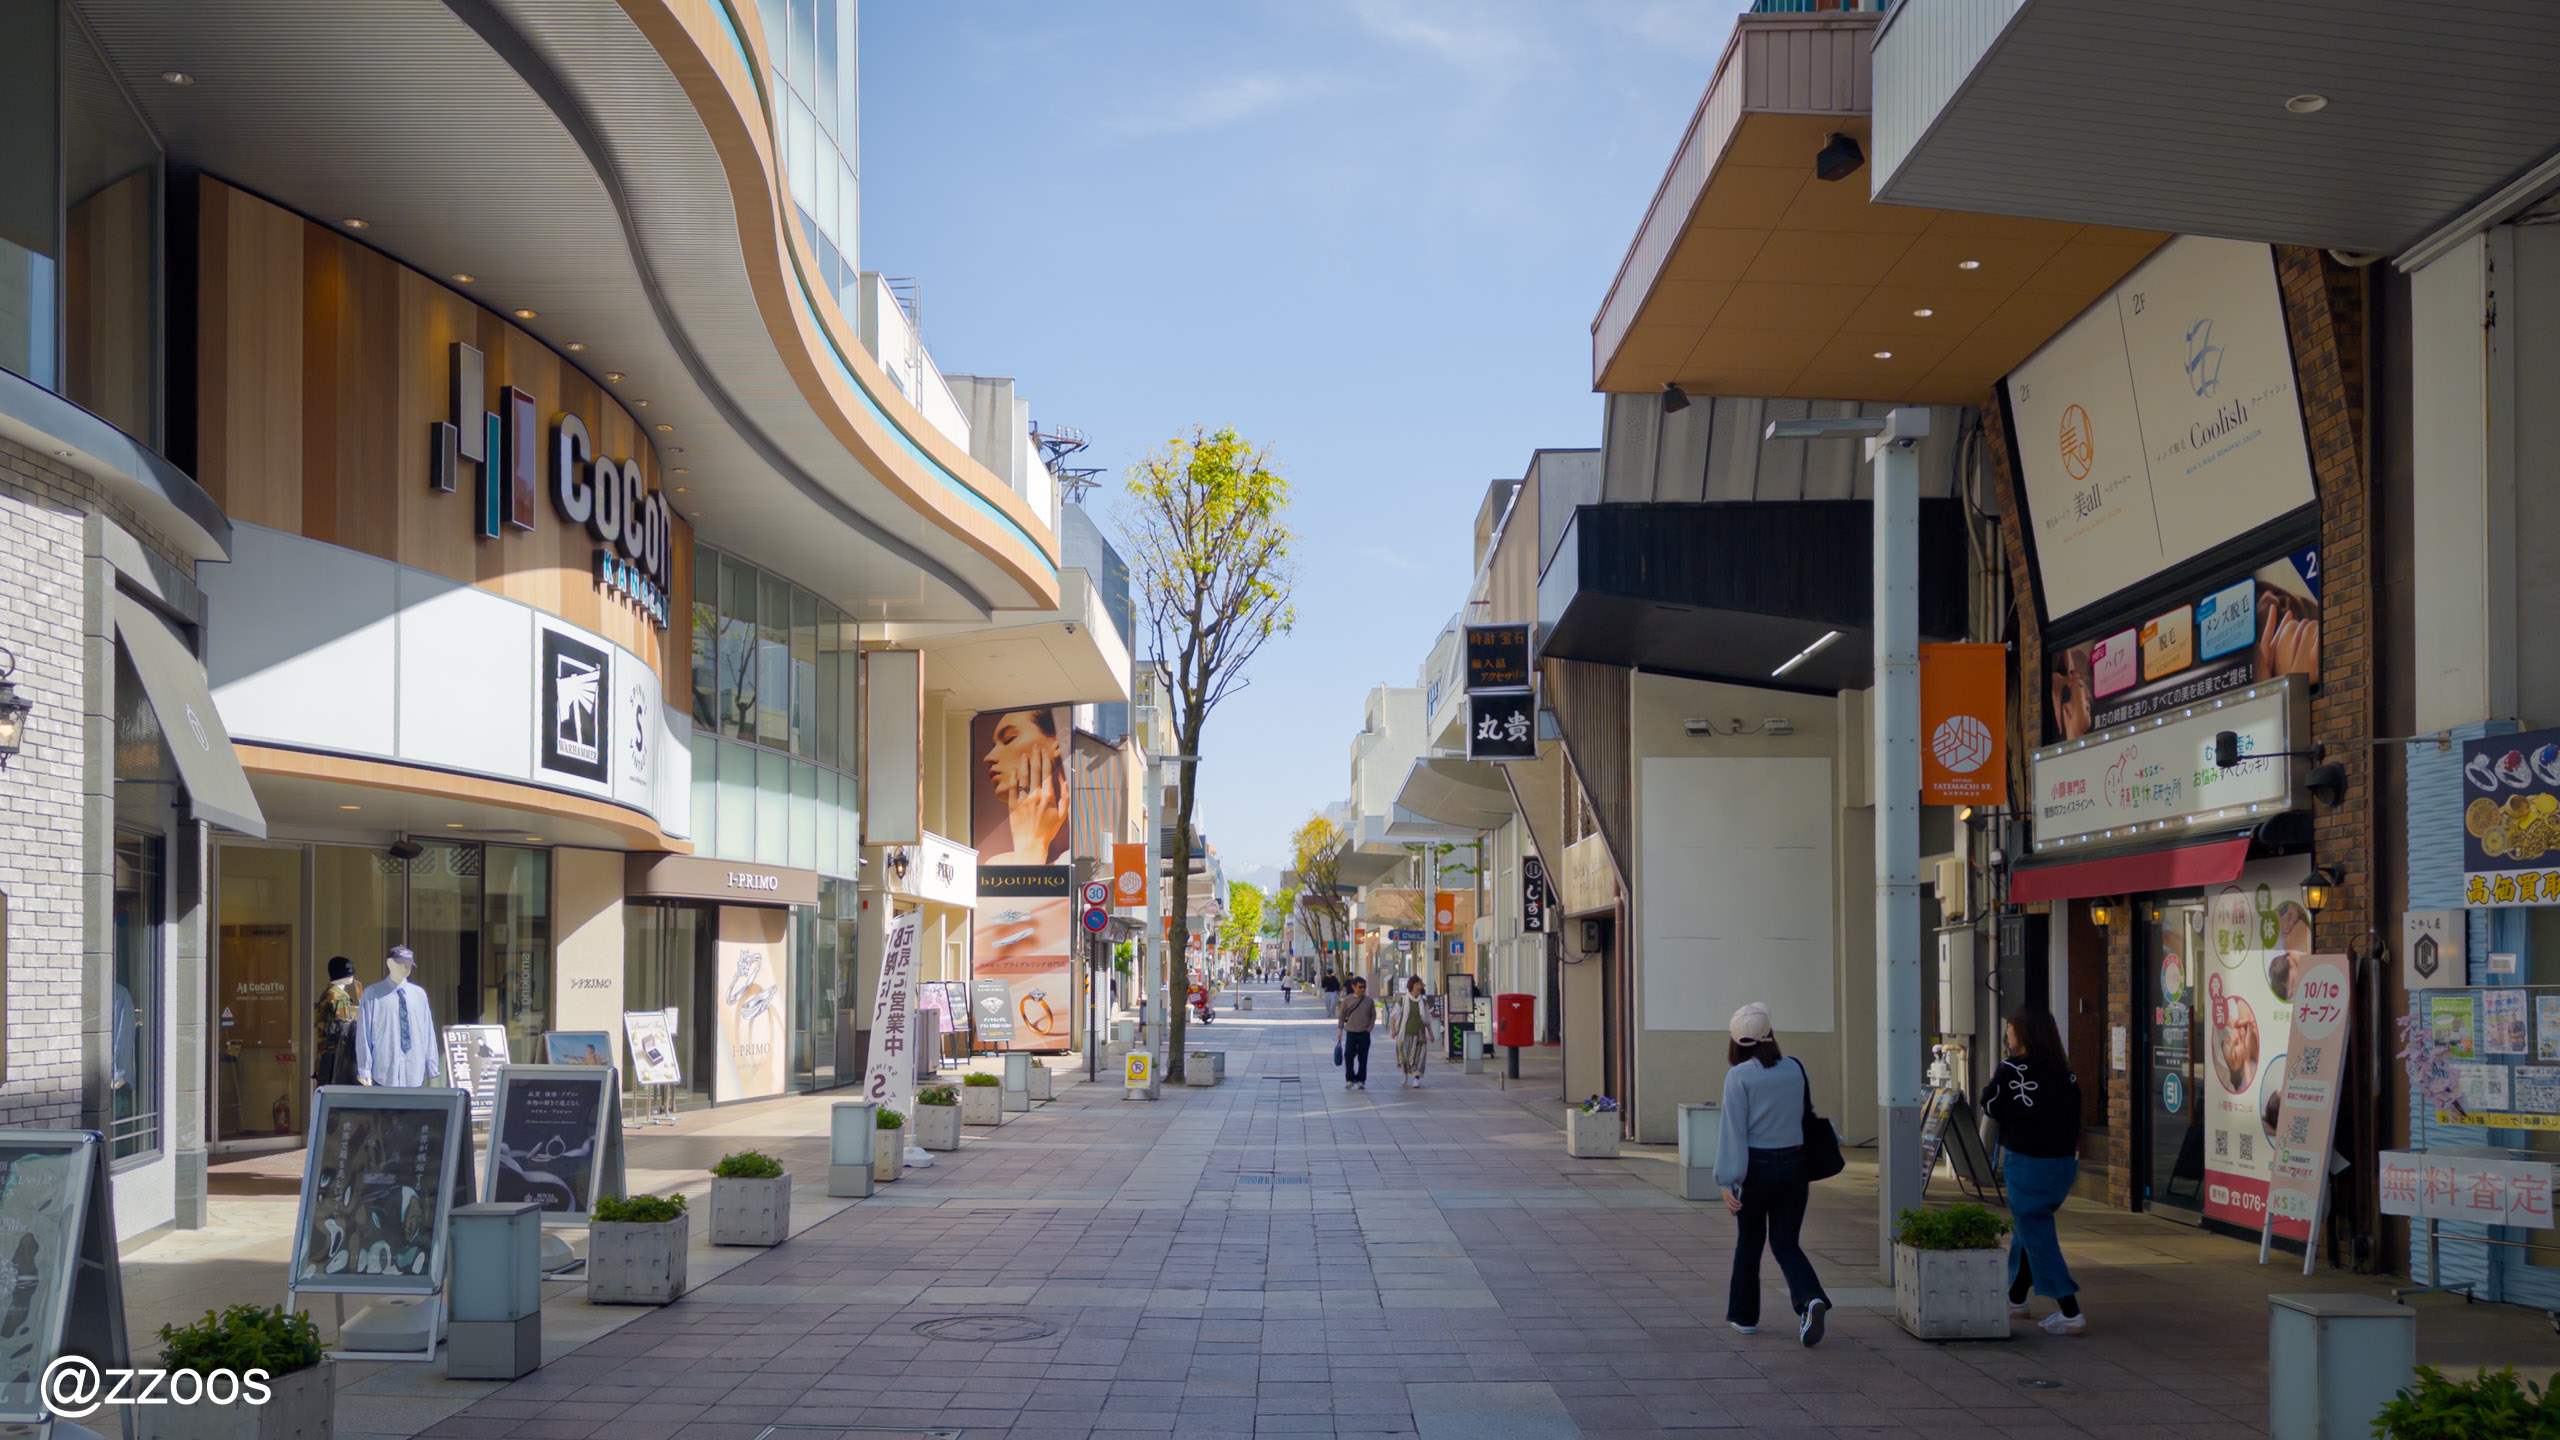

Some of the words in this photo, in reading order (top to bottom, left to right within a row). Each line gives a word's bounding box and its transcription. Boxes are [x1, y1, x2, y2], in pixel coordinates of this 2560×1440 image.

[2132, 292, 2147, 316] 2F
[2190, 398, 2248, 450] Coolish
[2073, 482, 2102, 523] 美all
[2205, 594, 2250, 637] メンズ脱毛
[1476, 709, 1531, 742] 丸貴
[558, 739, 598, 762] WARHAMMER
[2051, 779, 2087, 801] 小顔専門店
[727, 871, 778, 891] I-PRIMO
[1088, 887, 1104, 900] 30
[2218, 928, 2246, 955] 整体
[2304, 981, 2329, 999] 10/1
[2298, 1003, 2341, 1024] オープン
[732, 1043, 771, 1058] I-PRIMO
[2383, 1161, 2549, 1215] 無料査定
